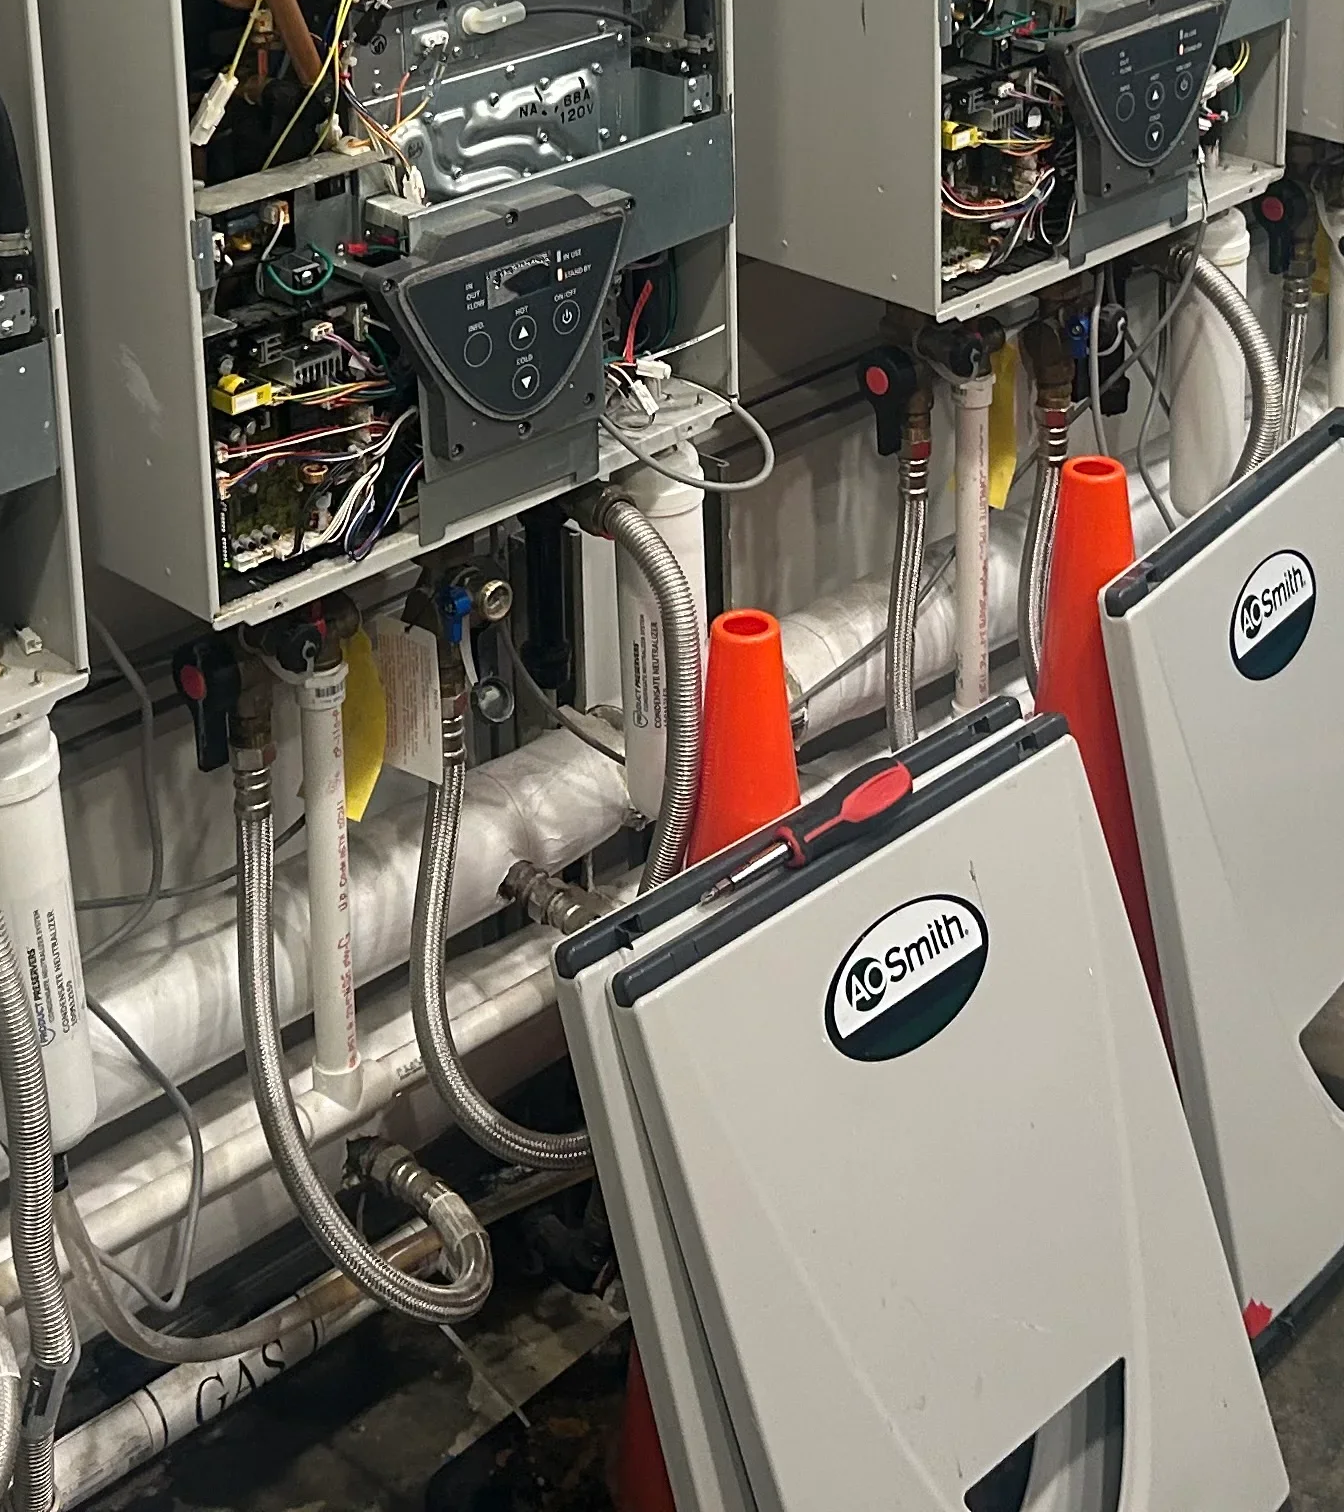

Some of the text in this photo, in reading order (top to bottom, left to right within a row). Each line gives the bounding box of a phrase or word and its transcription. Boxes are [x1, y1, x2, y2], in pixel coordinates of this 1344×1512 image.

[561, 103, 593, 124] 120V
[47, 909, 70, 1033] CONDENSATE NEUTRALIZER
[35, 1003, 49, 1043] PRODUCT
[196, 1339, 286, 1424] GAS
